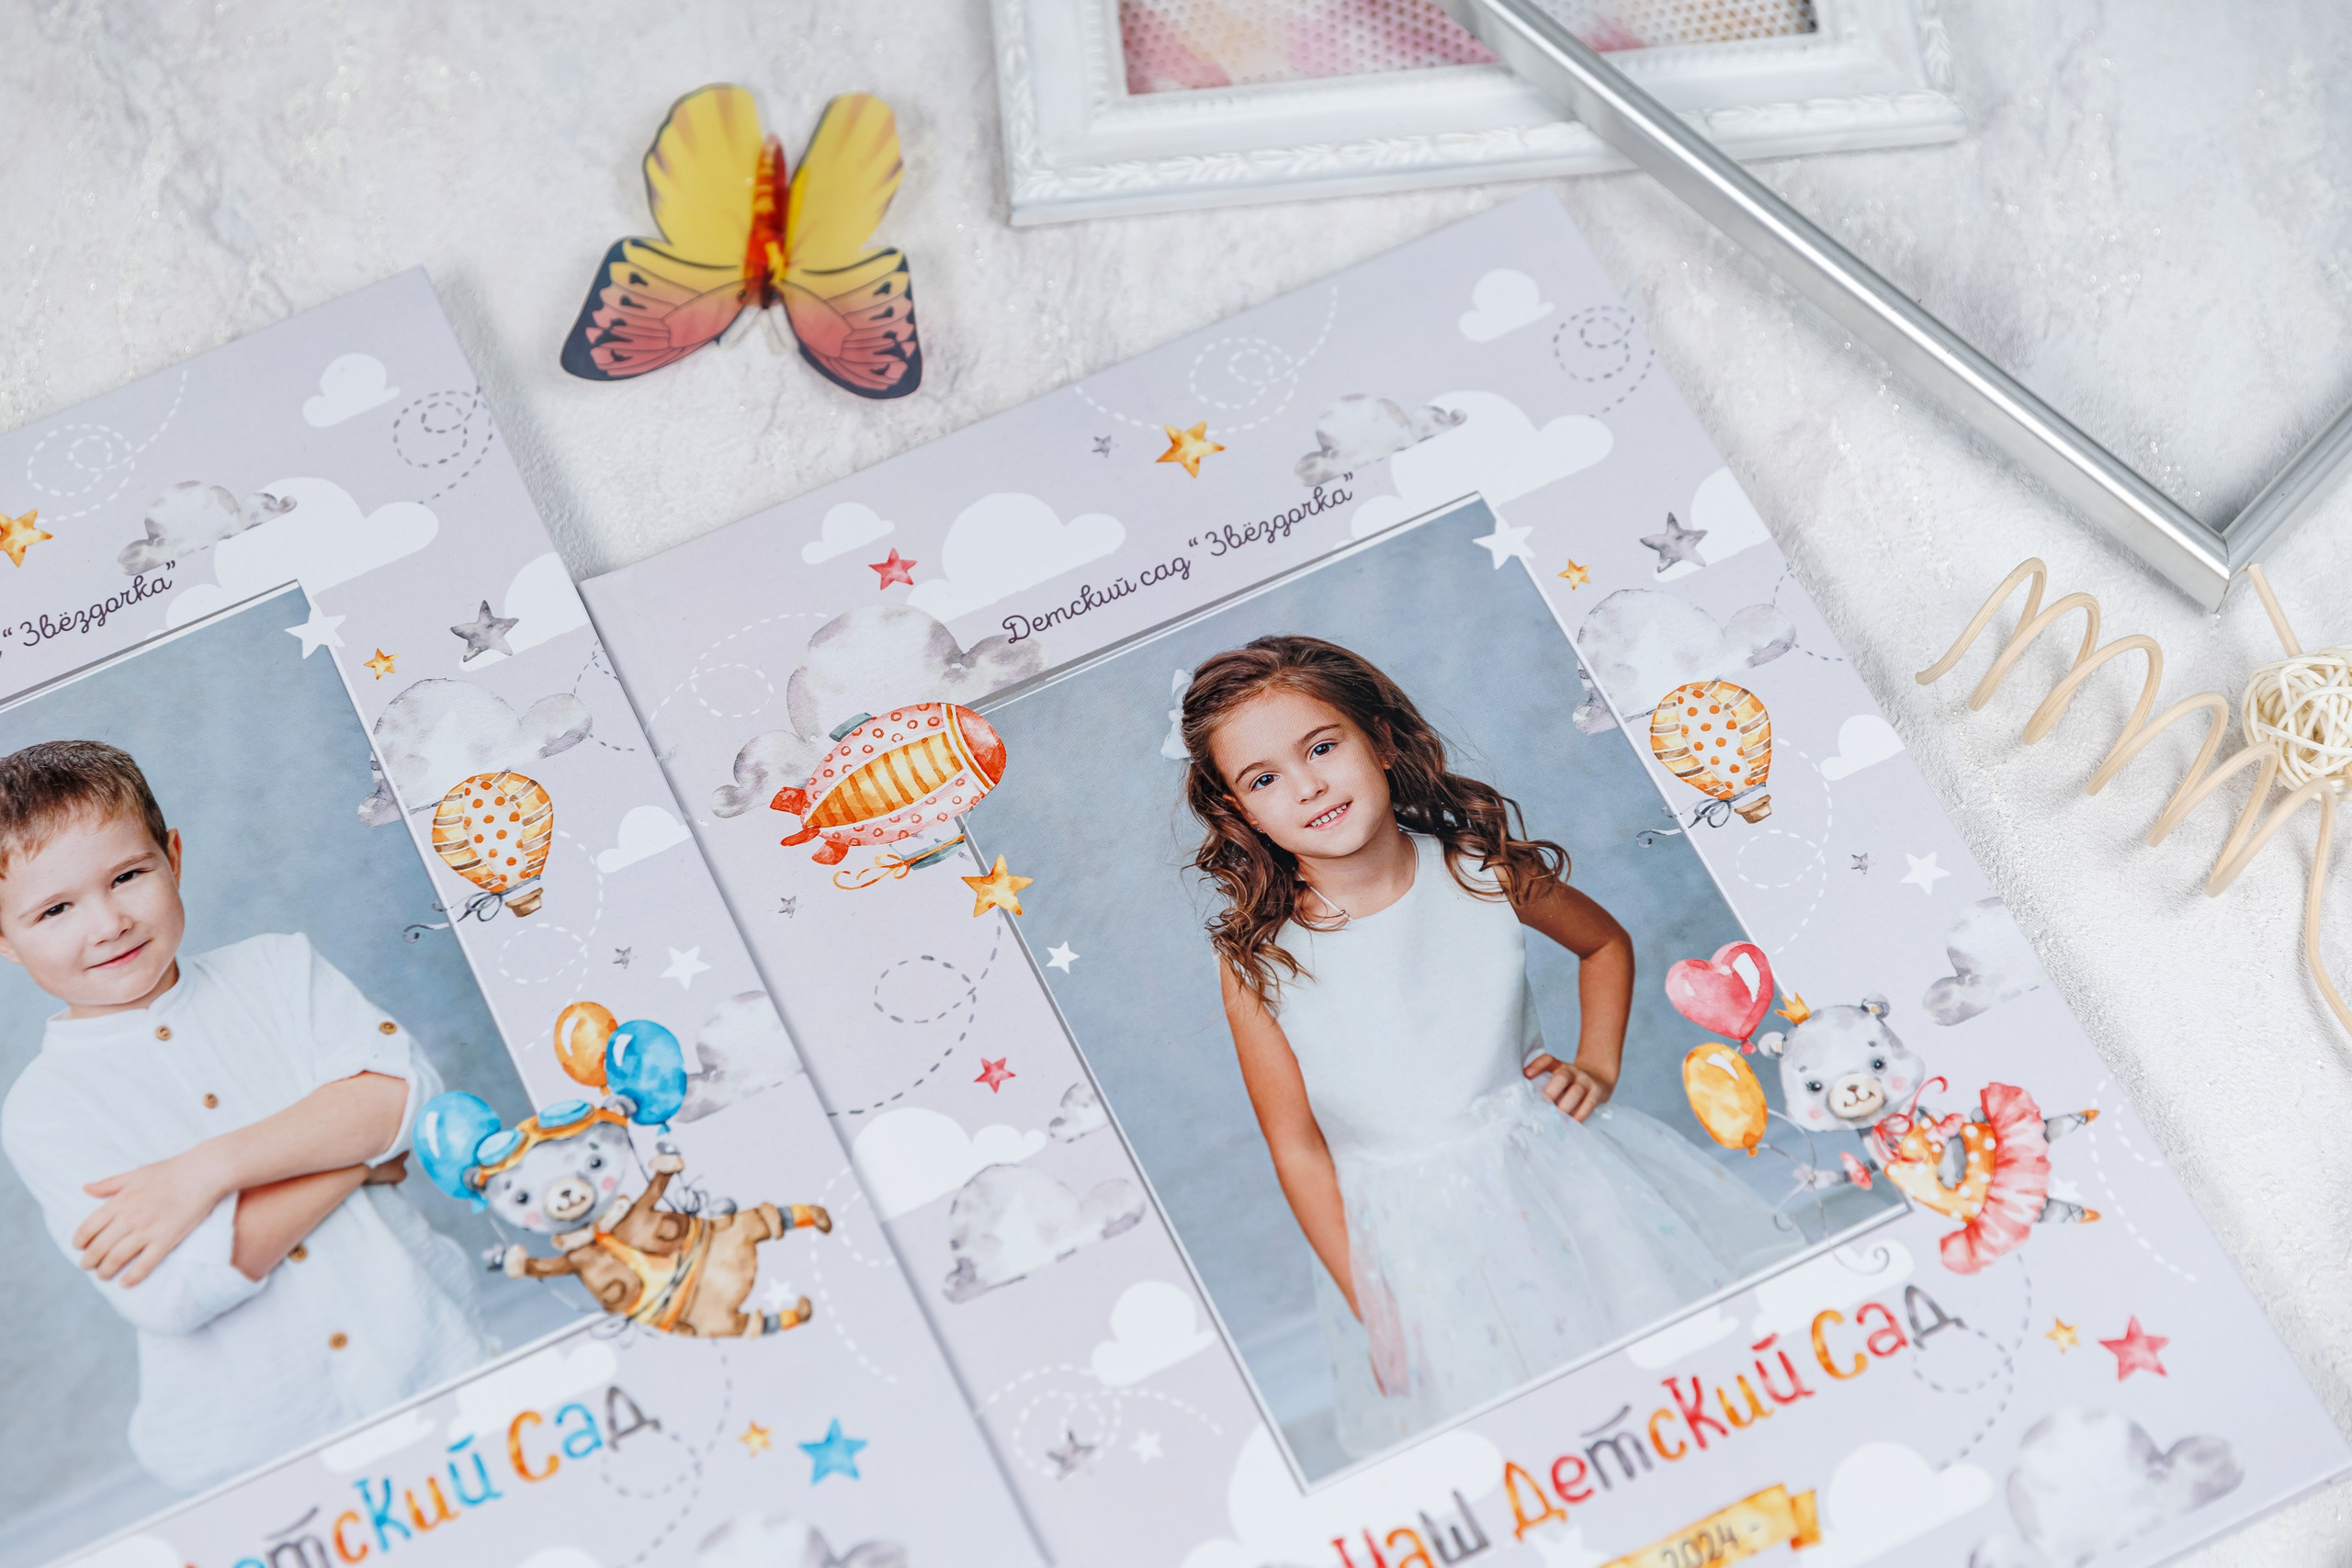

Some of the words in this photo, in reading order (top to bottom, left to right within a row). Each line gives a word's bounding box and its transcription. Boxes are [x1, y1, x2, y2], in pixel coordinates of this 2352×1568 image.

[1001, 576, 1137, 644] Детский
[1139, 554, 1193, 586] сад
[185, 1433, 504, 1568] тский
[506, 1384, 662, 1483] Сад
[1502, 1333, 1815, 1543] Детский
[1810, 1285, 1968, 1382] Сад
